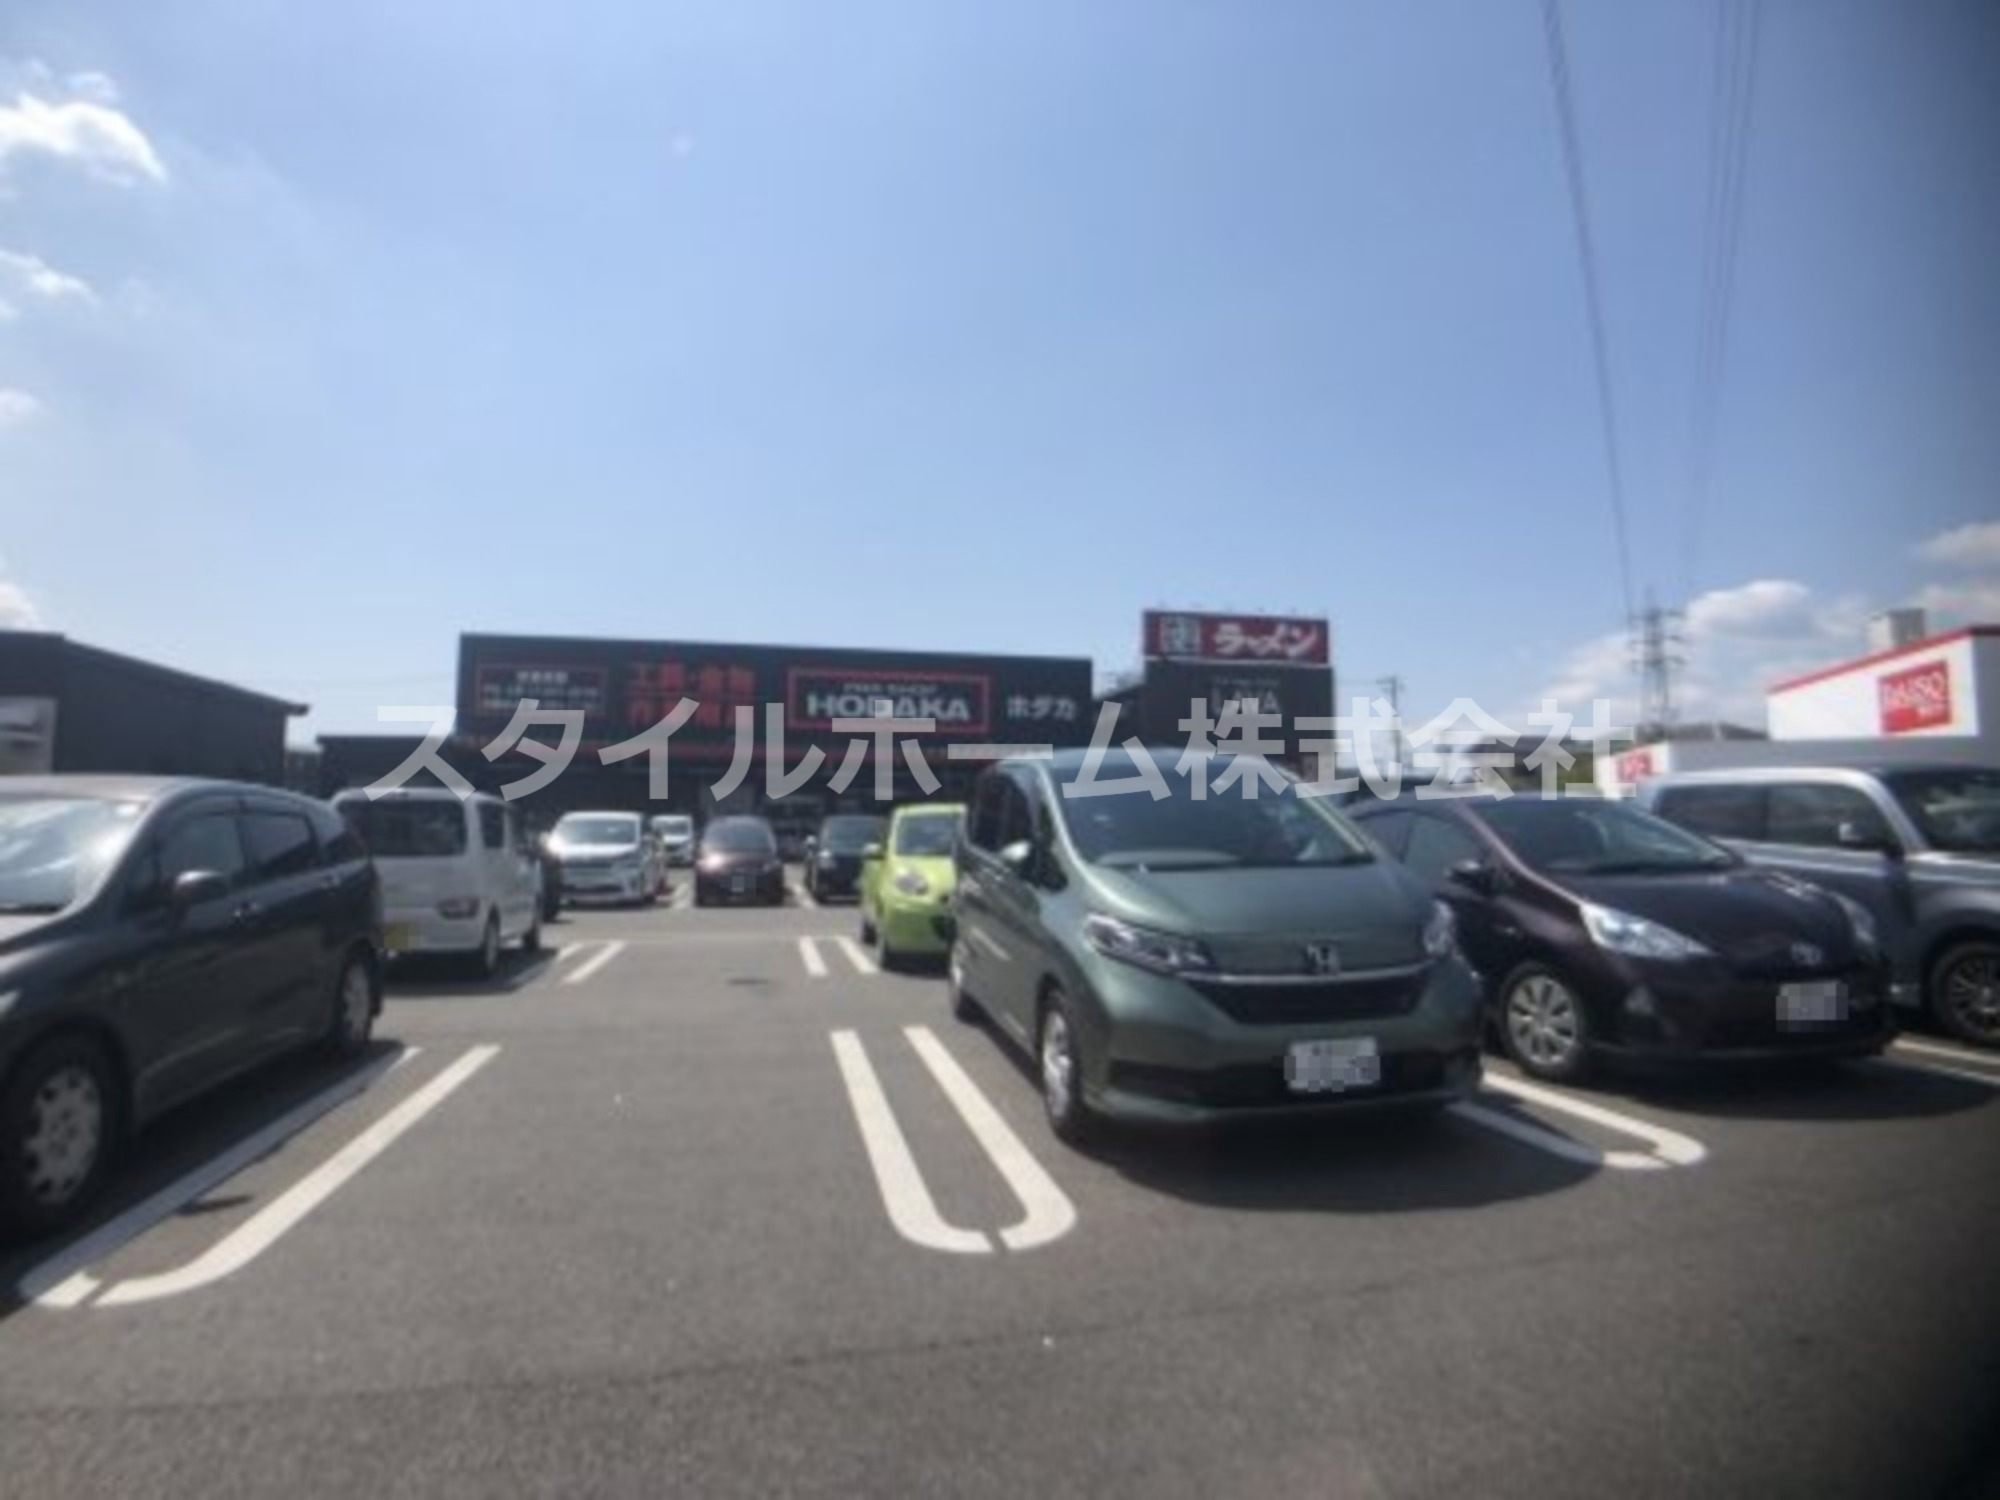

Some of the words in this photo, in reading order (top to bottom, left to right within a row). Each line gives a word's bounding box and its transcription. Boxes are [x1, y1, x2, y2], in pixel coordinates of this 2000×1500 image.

[1214, 622, 1319, 658] ラーメン
[806, 694, 972, 721] HODAKA
[1007, 696, 1078, 720] ホダカ
